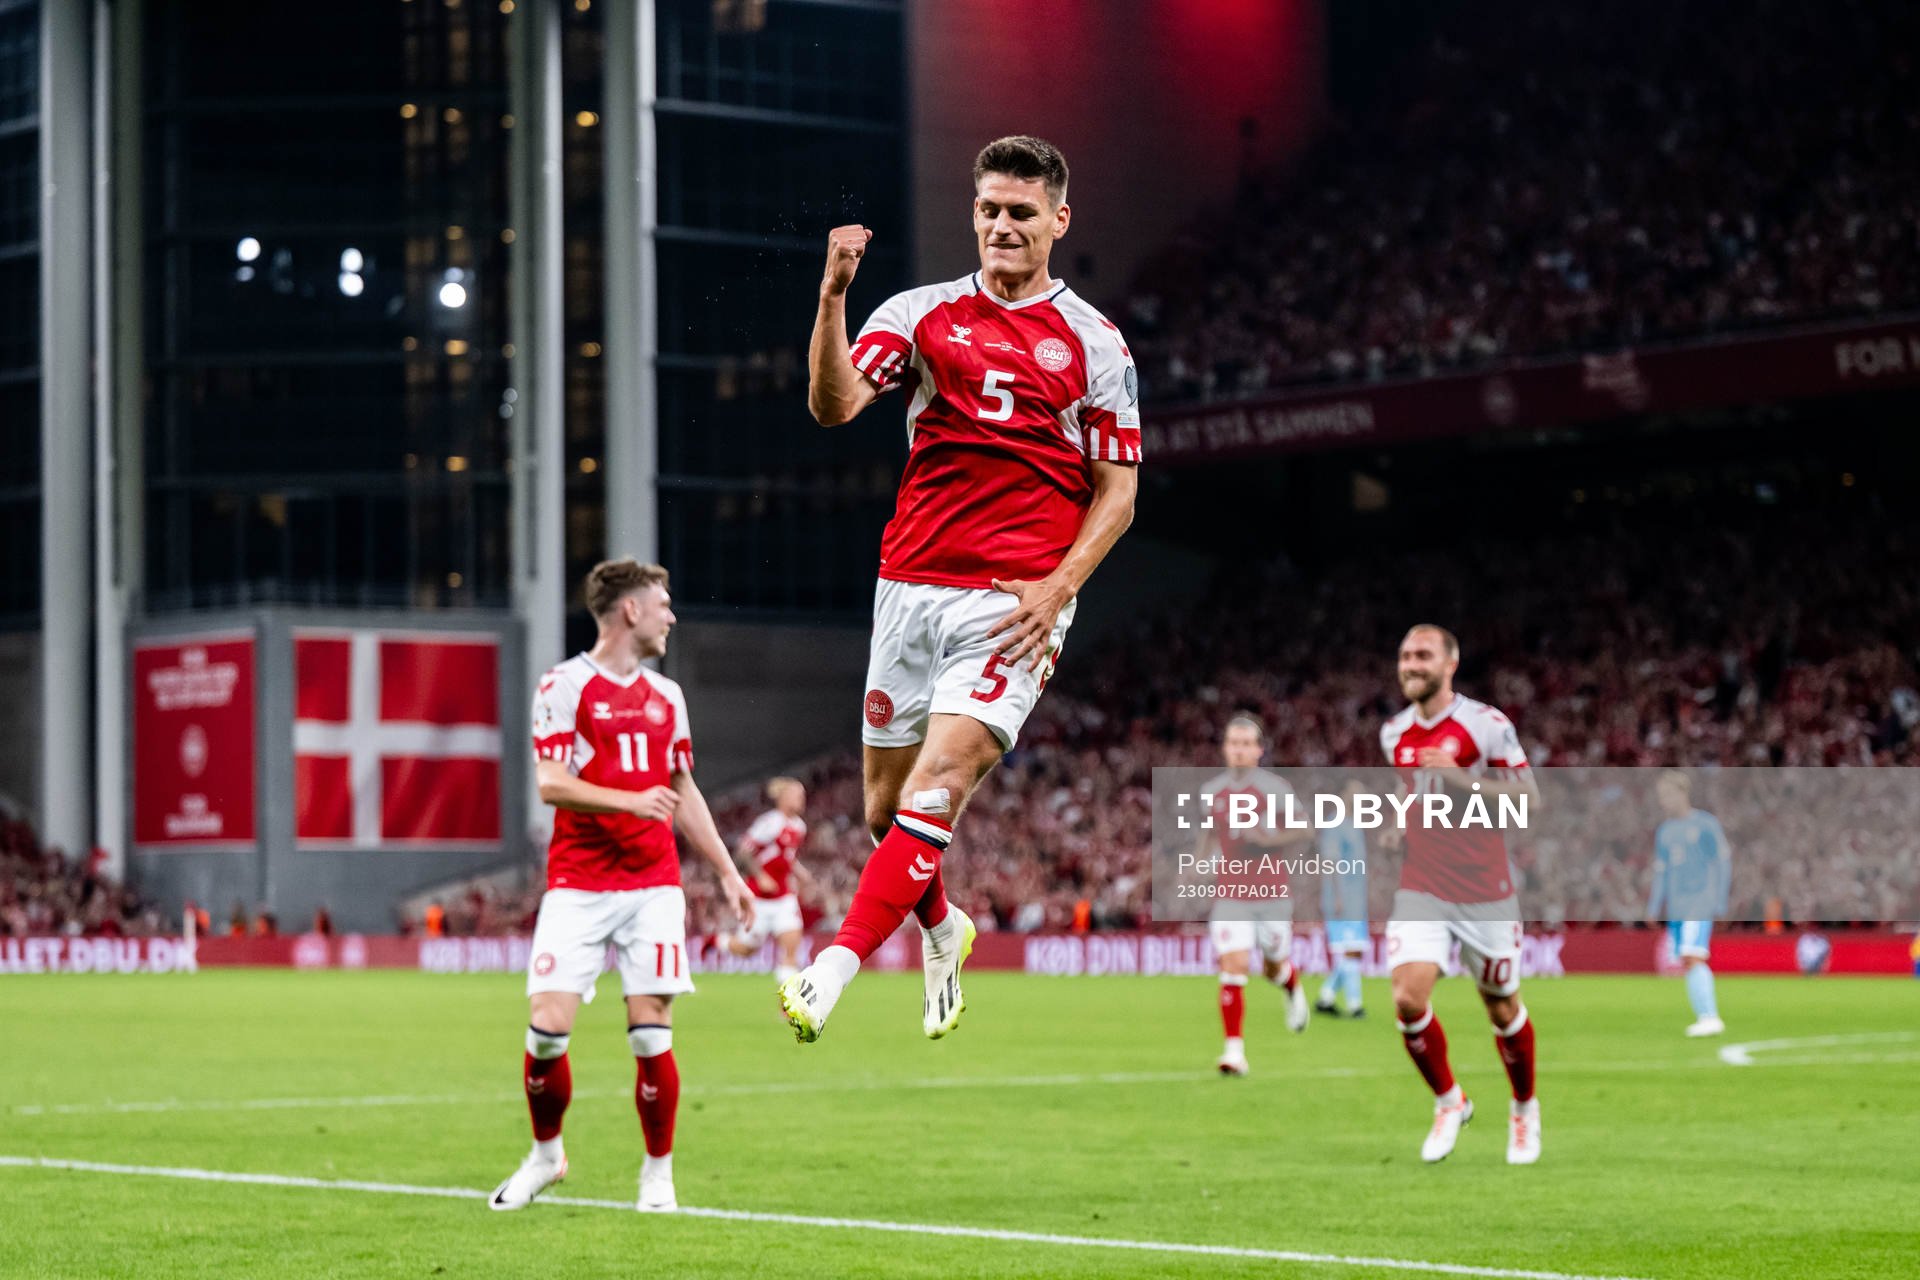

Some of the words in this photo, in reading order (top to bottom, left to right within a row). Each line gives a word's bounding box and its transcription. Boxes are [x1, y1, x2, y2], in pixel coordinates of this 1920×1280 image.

[1042, 348, 1065, 362] DBU
[1834, 337, 1905, 376] FOR
[977, 369, 1016, 421] 5
[1255, 401, 1375, 442] SAMMEN
[969, 654, 1013, 703] 5
[869, 701, 886, 714] DBU
[617, 732, 650, 772] 11
[655, 943, 680, 978] 11
[1025, 936, 1084, 975] KØB
[1087, 936, 1138, 975] DIN
[1483, 957, 1512, 985] 10
